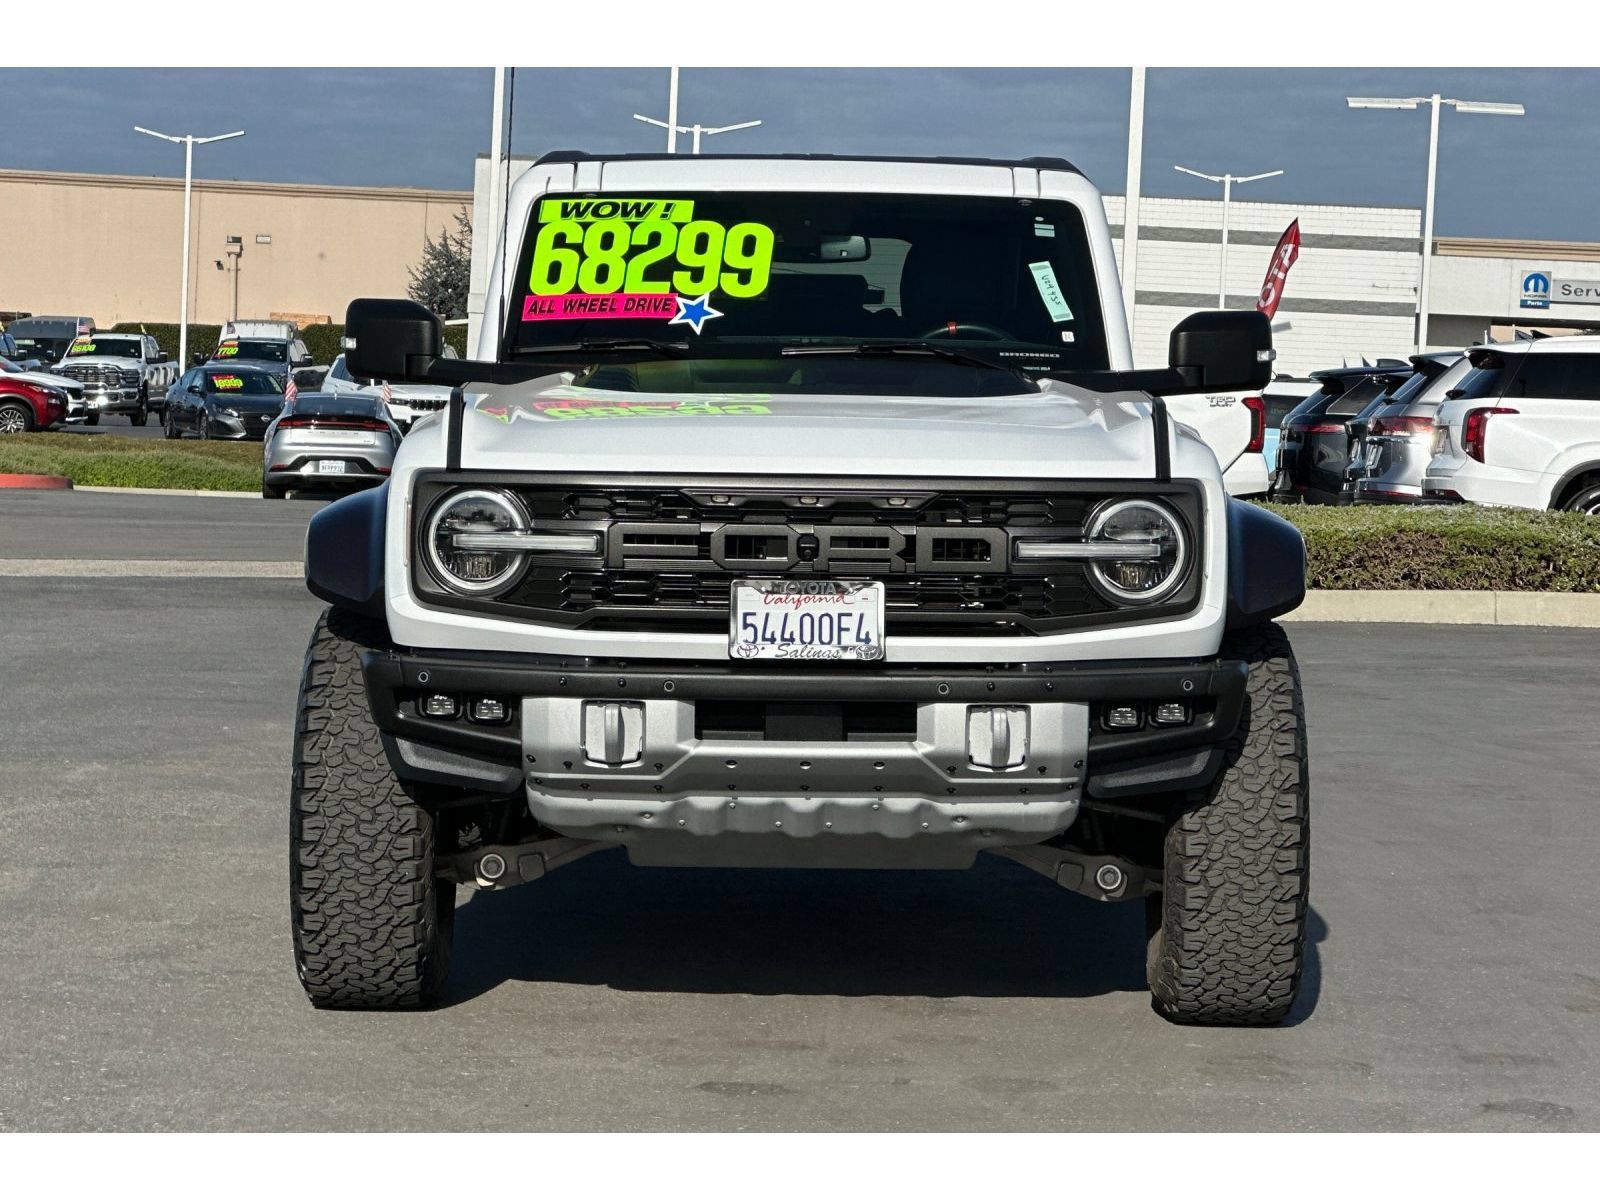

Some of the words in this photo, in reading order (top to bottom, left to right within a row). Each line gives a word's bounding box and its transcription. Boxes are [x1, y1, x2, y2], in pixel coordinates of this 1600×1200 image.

[529, 220, 775, 298] 68299
[527, 300, 555, 315] ALL
[563, 298, 617, 313] WHEEL
[623, 298, 672, 313] DRIVE
[608, 523, 1008, 574] FORD
[779, 581, 837, 595] TOYOTA
[764, 591, 854, 610] California
[742, 612, 872, 645] 54400F4
[775, 643, 842, 659] Salinas
